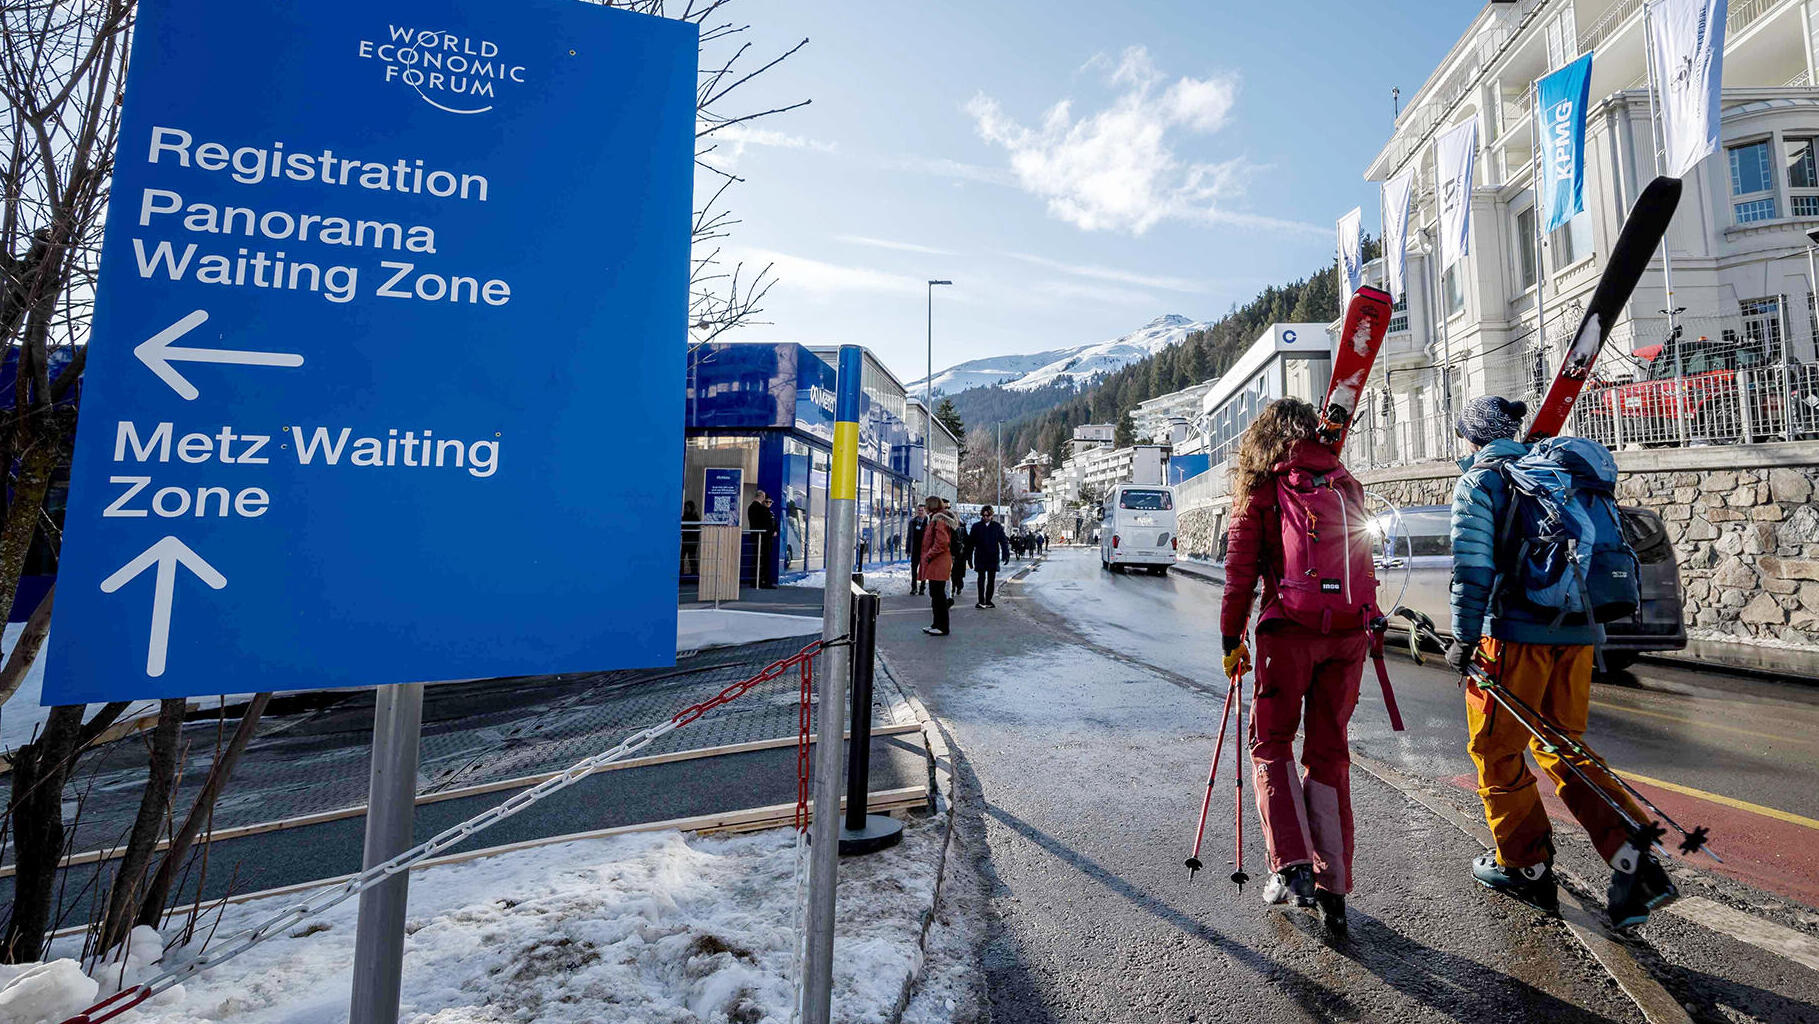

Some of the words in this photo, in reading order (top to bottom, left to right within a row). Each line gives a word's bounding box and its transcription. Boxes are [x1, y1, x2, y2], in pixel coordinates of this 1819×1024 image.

[359, 40, 526, 83] ECONOMIC
[388, 24, 499, 58] WORLD
[385, 65, 494, 98] FORUM
[148, 126, 488, 201] Registration
[1556, 101, 1573, 180] KPMG
[139, 188, 437, 255] Panorama
[132, 238, 359, 303] Waiting
[376, 260, 511, 306] Zone
[114, 421, 271, 465] Metz
[291, 426, 500, 478] Waiting
[102, 475, 270, 518] Zone
